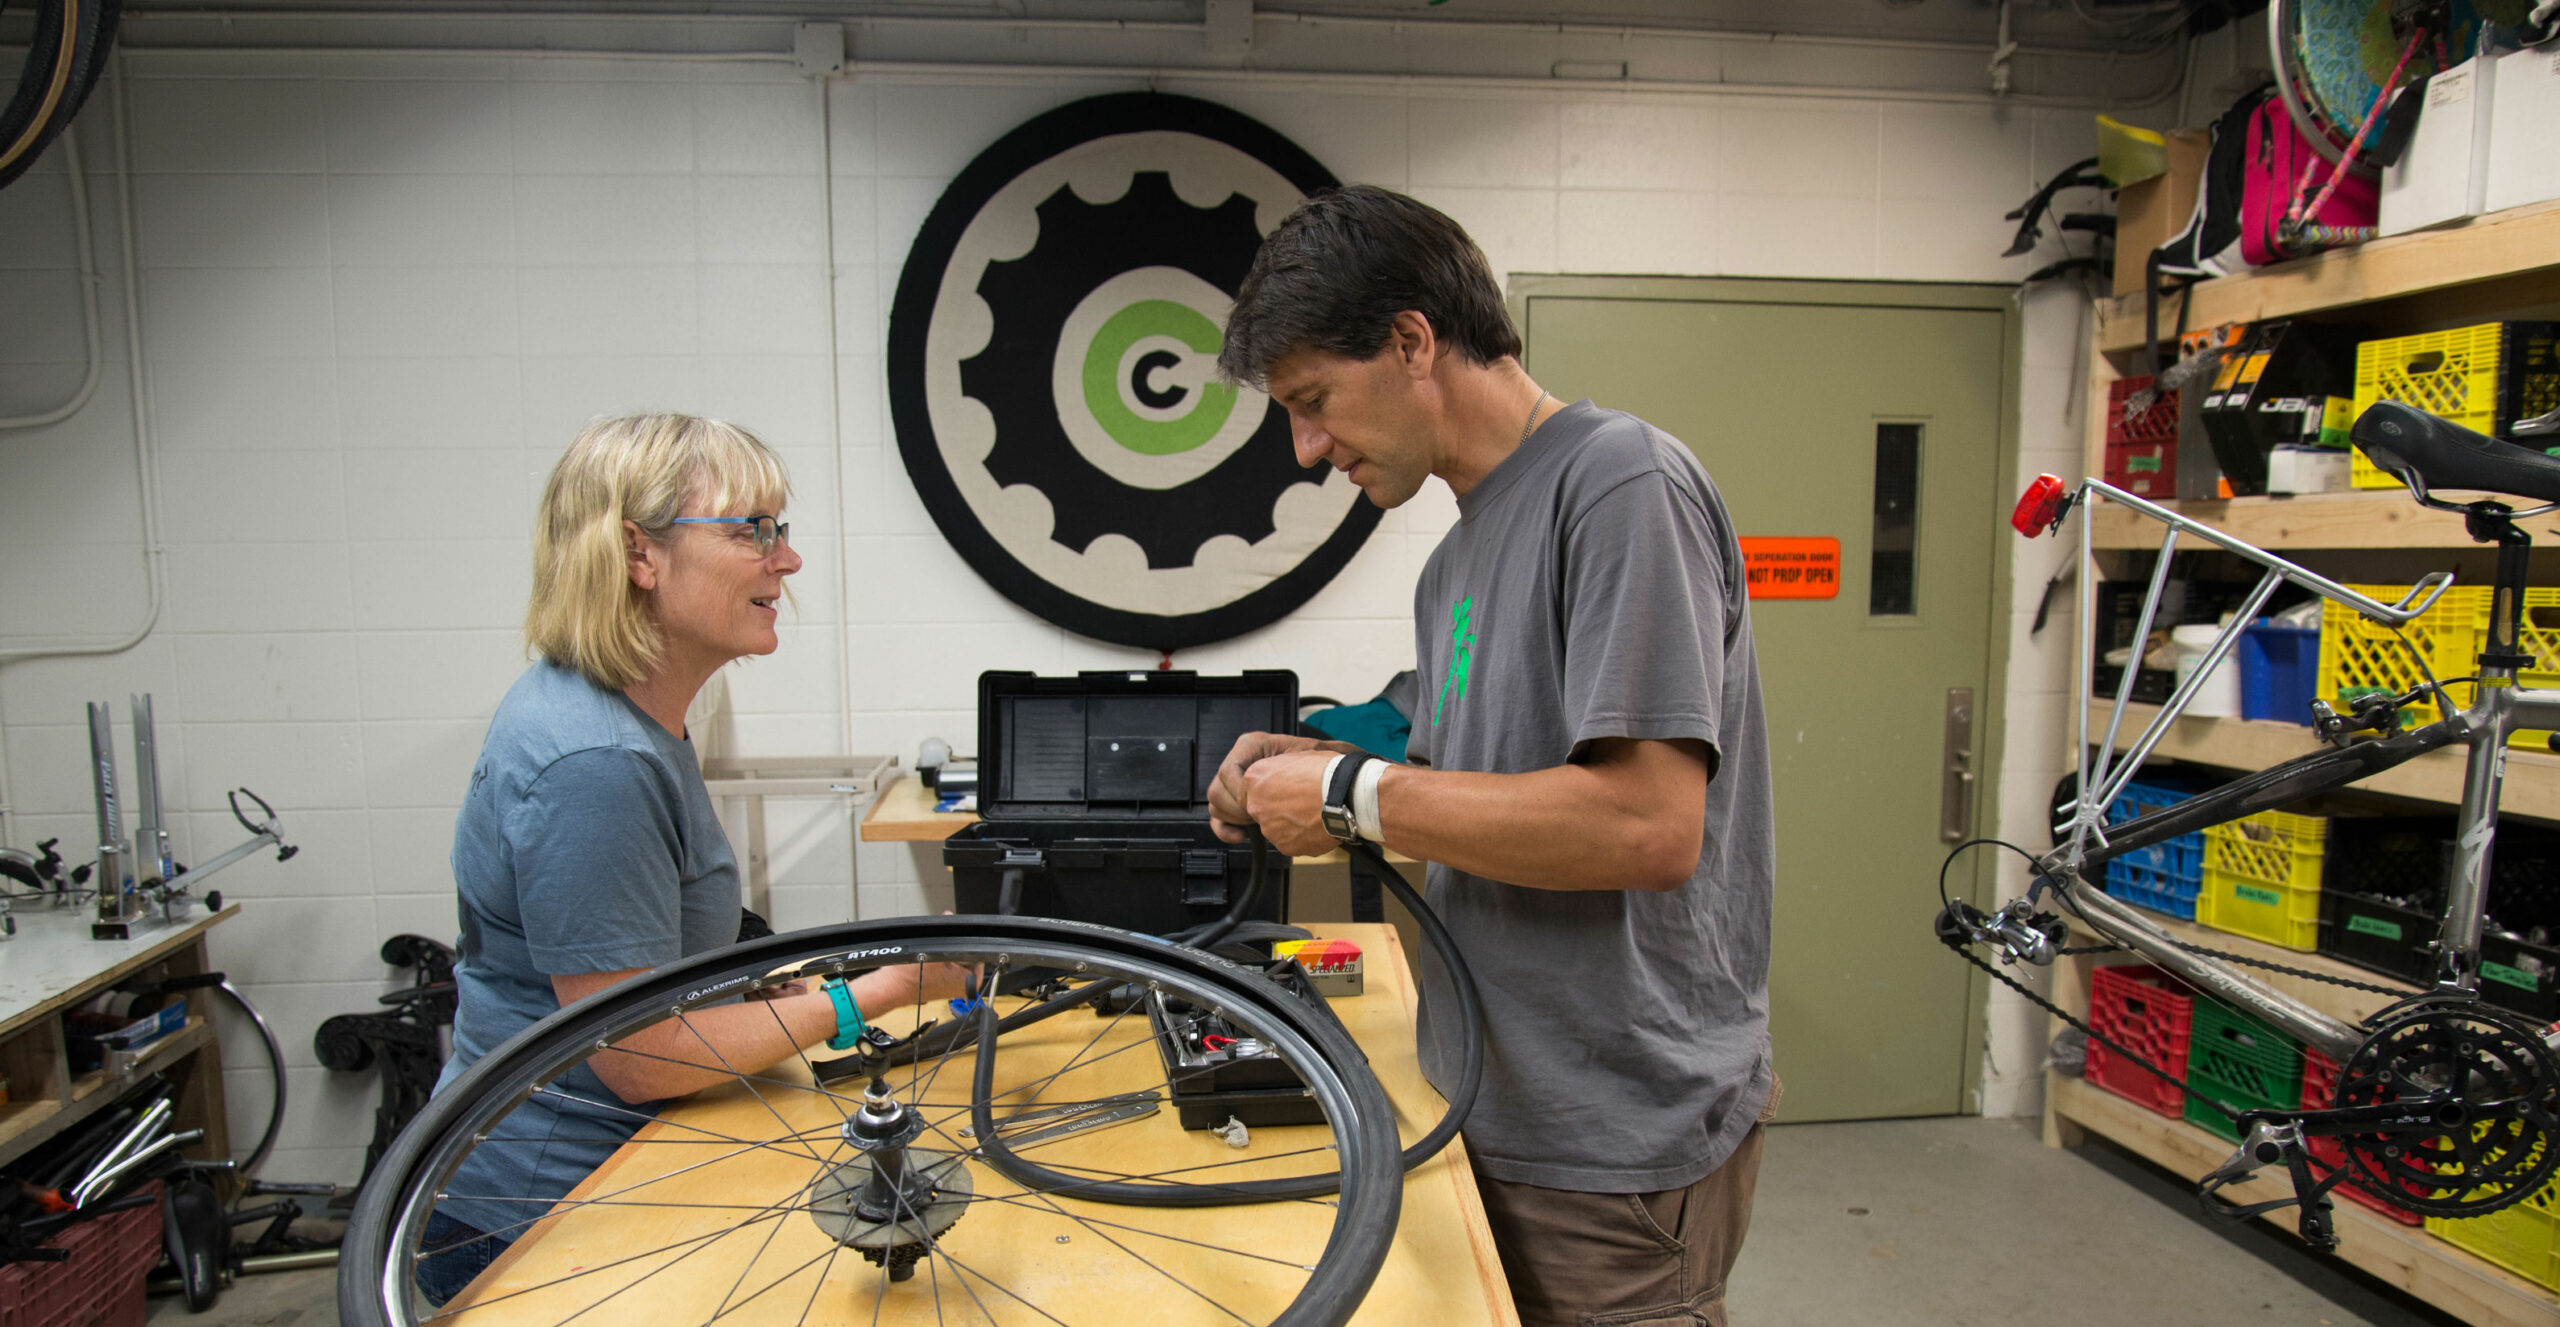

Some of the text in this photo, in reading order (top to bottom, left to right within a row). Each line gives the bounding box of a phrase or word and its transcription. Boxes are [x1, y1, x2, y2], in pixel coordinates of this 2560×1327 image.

[1748, 567, 1835, 583] NOT PROP OPEN
[1174, 943, 1236, 969] LUGANO
[701, 975, 750, 996] ALEXRIMS
